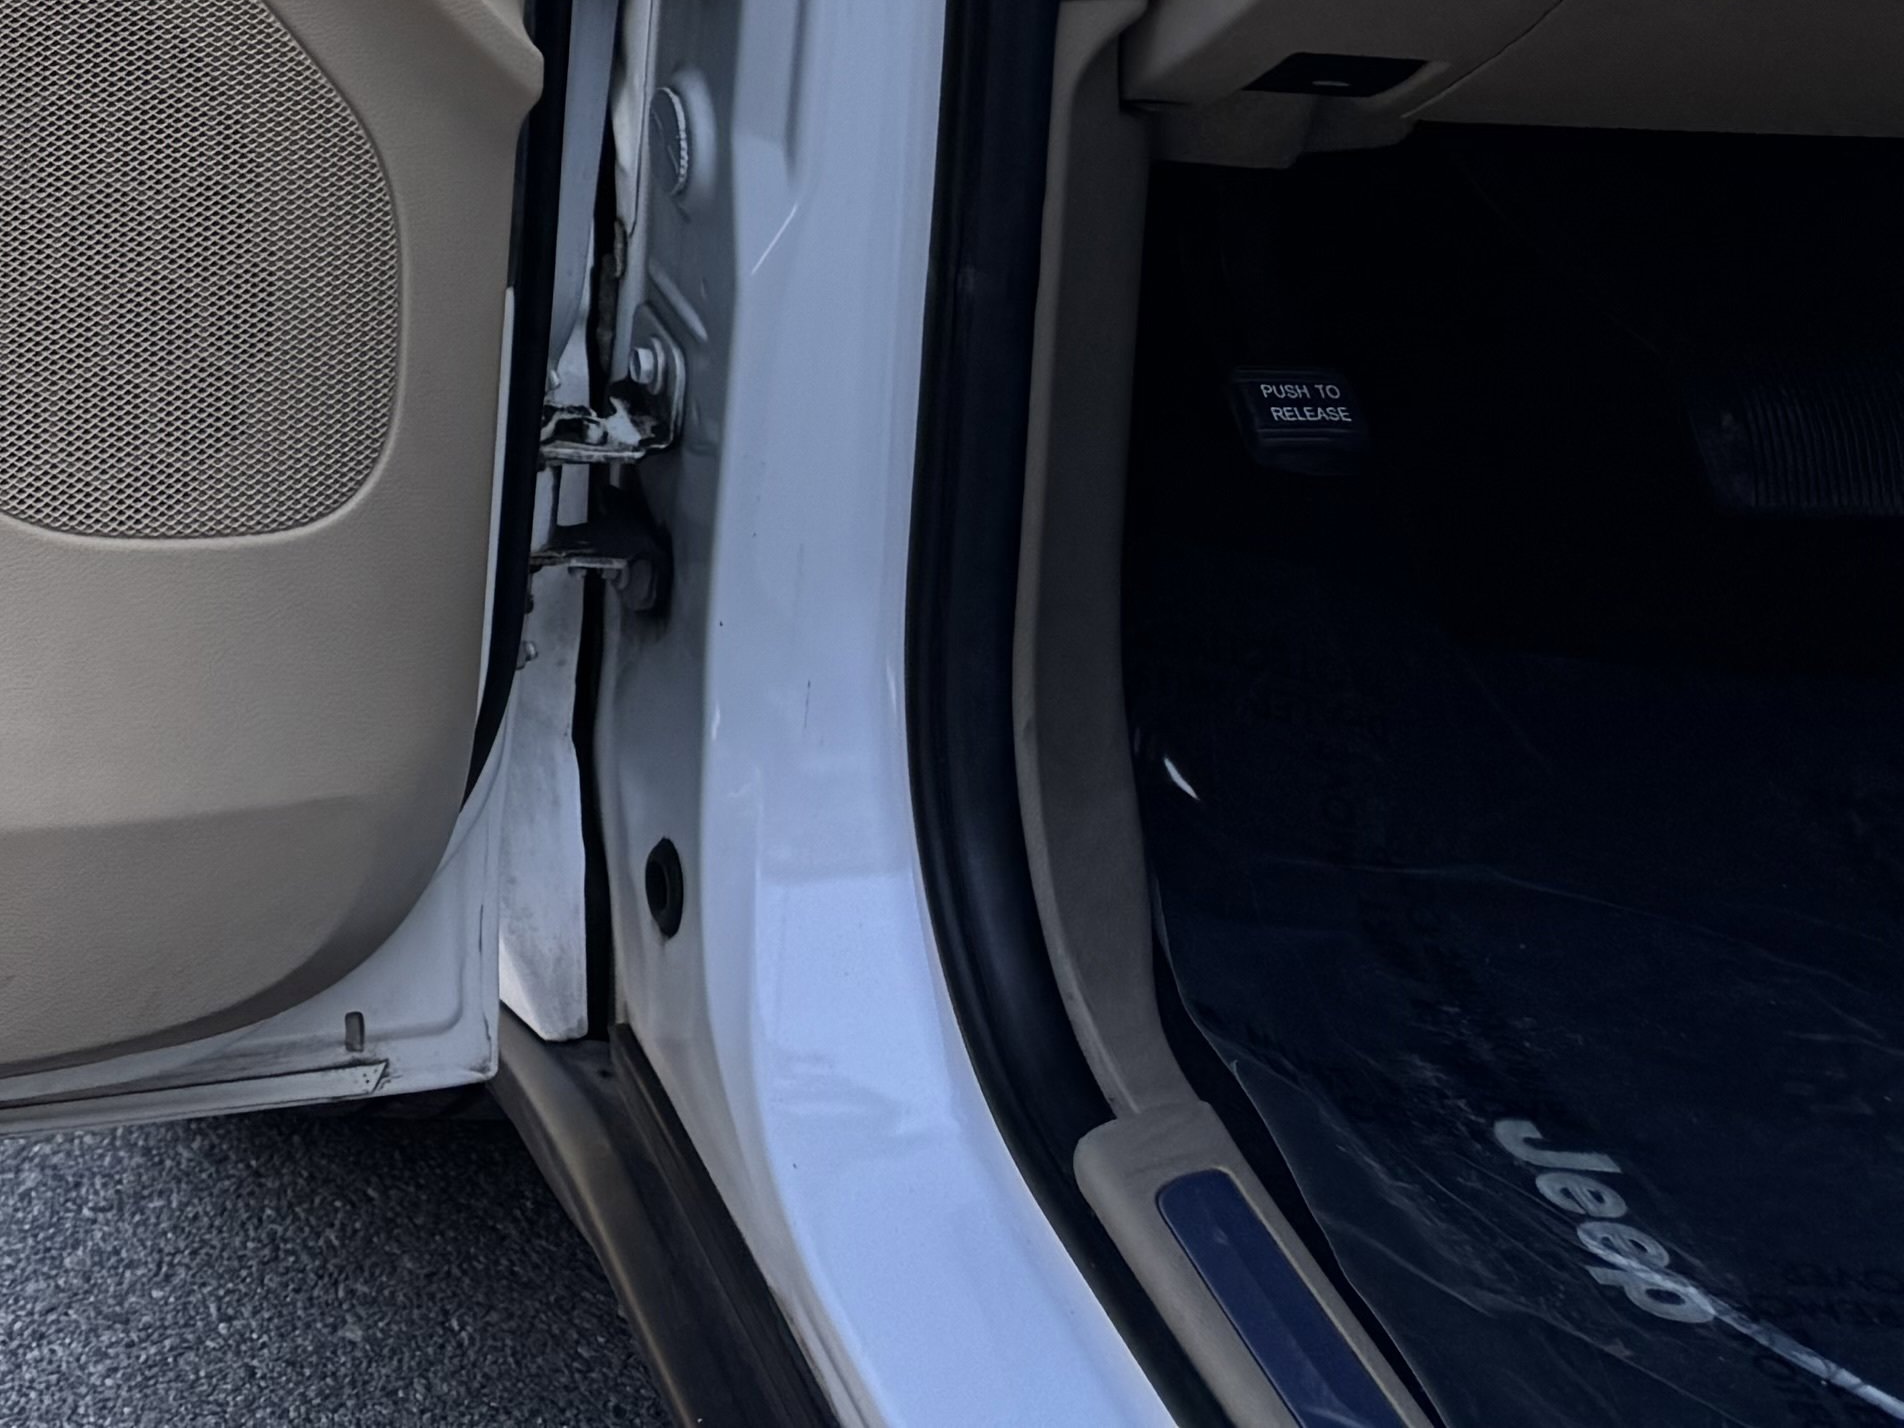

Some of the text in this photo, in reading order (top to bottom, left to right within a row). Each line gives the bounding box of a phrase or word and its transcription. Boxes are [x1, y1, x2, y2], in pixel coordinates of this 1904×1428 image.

[1260, 384, 1341, 400] PUSH TO
[1270, 406, 1352, 422] RELEASE
[1493, 1118, 1716, 1324] Jeep
